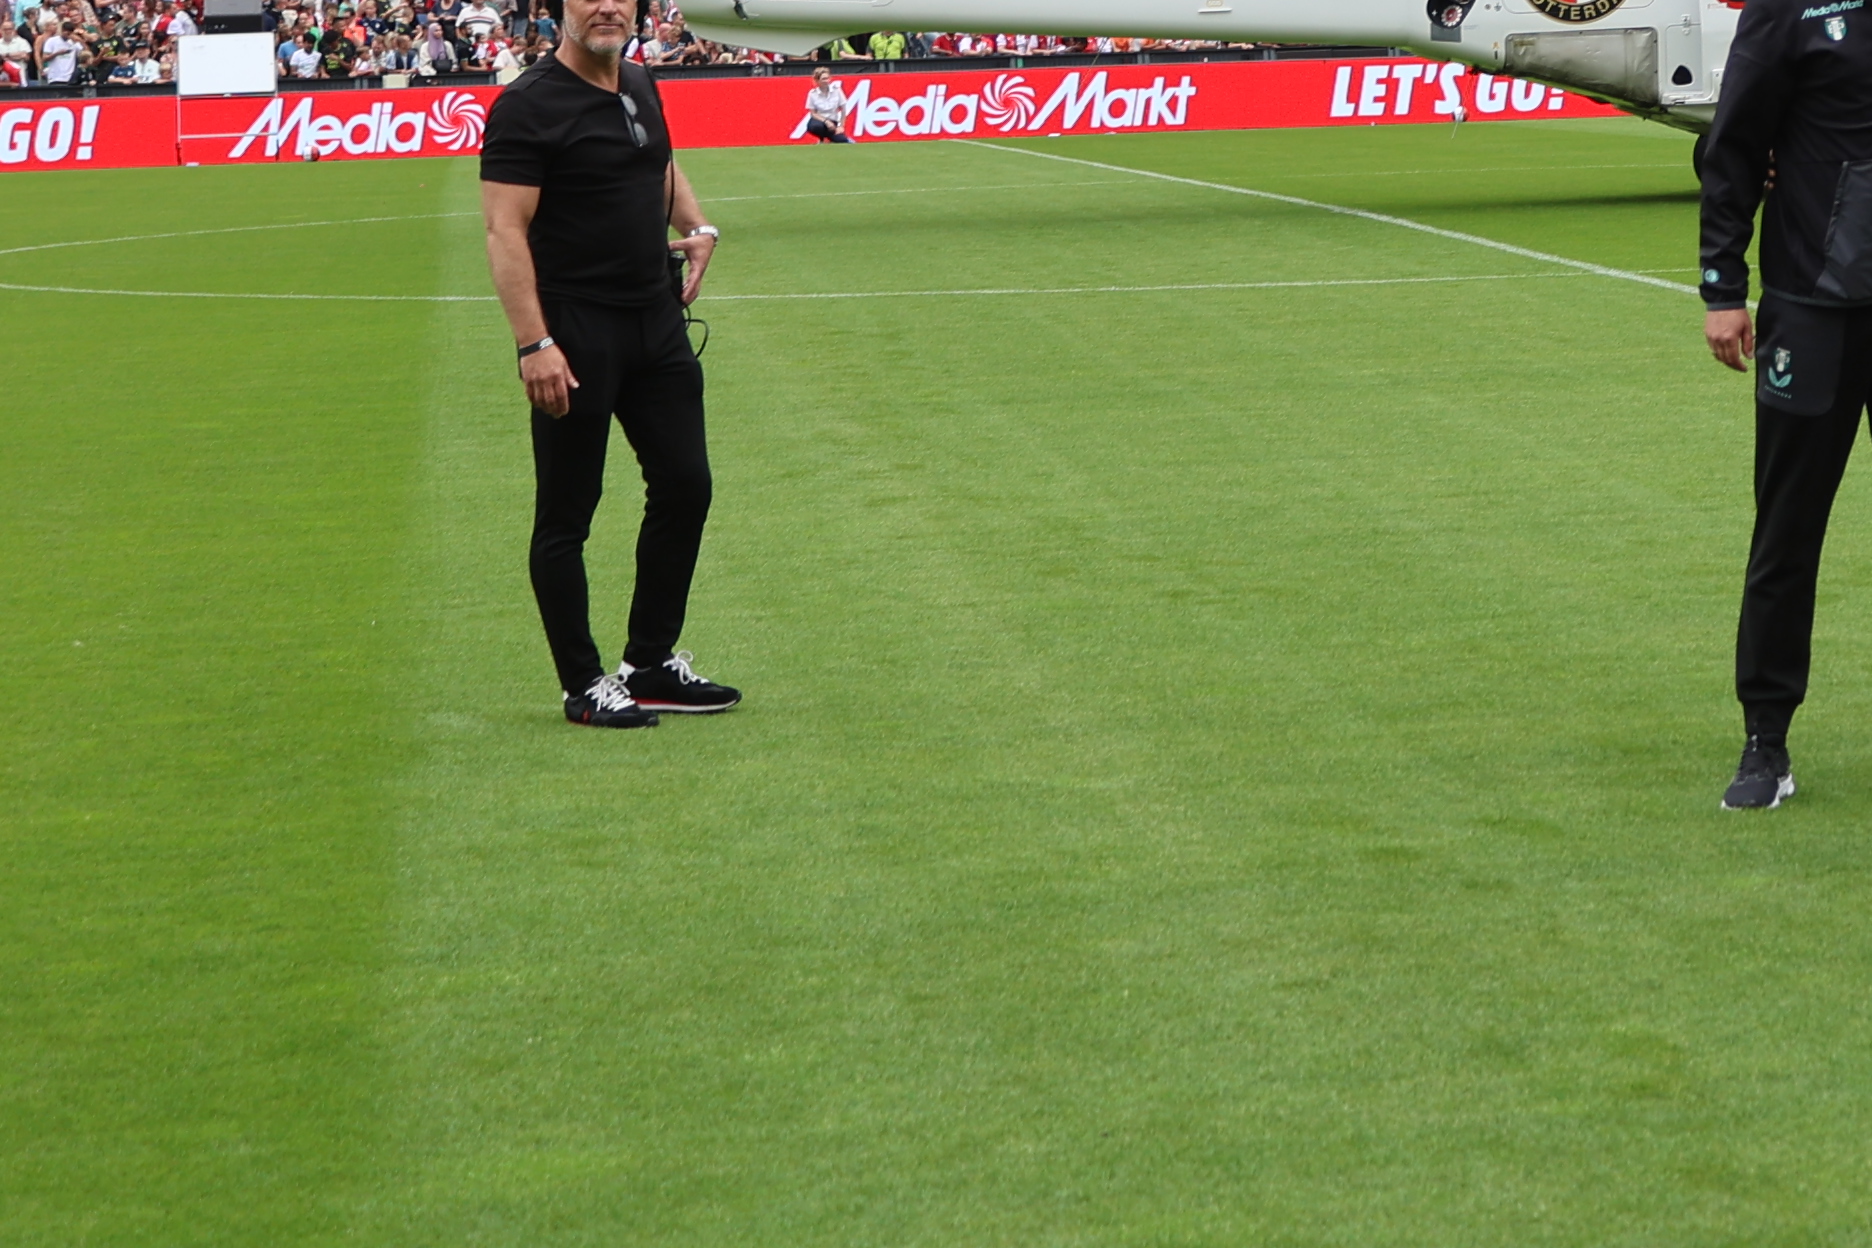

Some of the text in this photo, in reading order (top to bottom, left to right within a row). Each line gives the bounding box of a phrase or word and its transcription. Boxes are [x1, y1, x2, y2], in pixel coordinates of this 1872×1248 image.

[789, 71, 1196, 139] Media Markt
[1329, 62, 1465, 117] LET'S
[0, 105, 100, 163] GO!
[228, 97, 426, 158] Media
